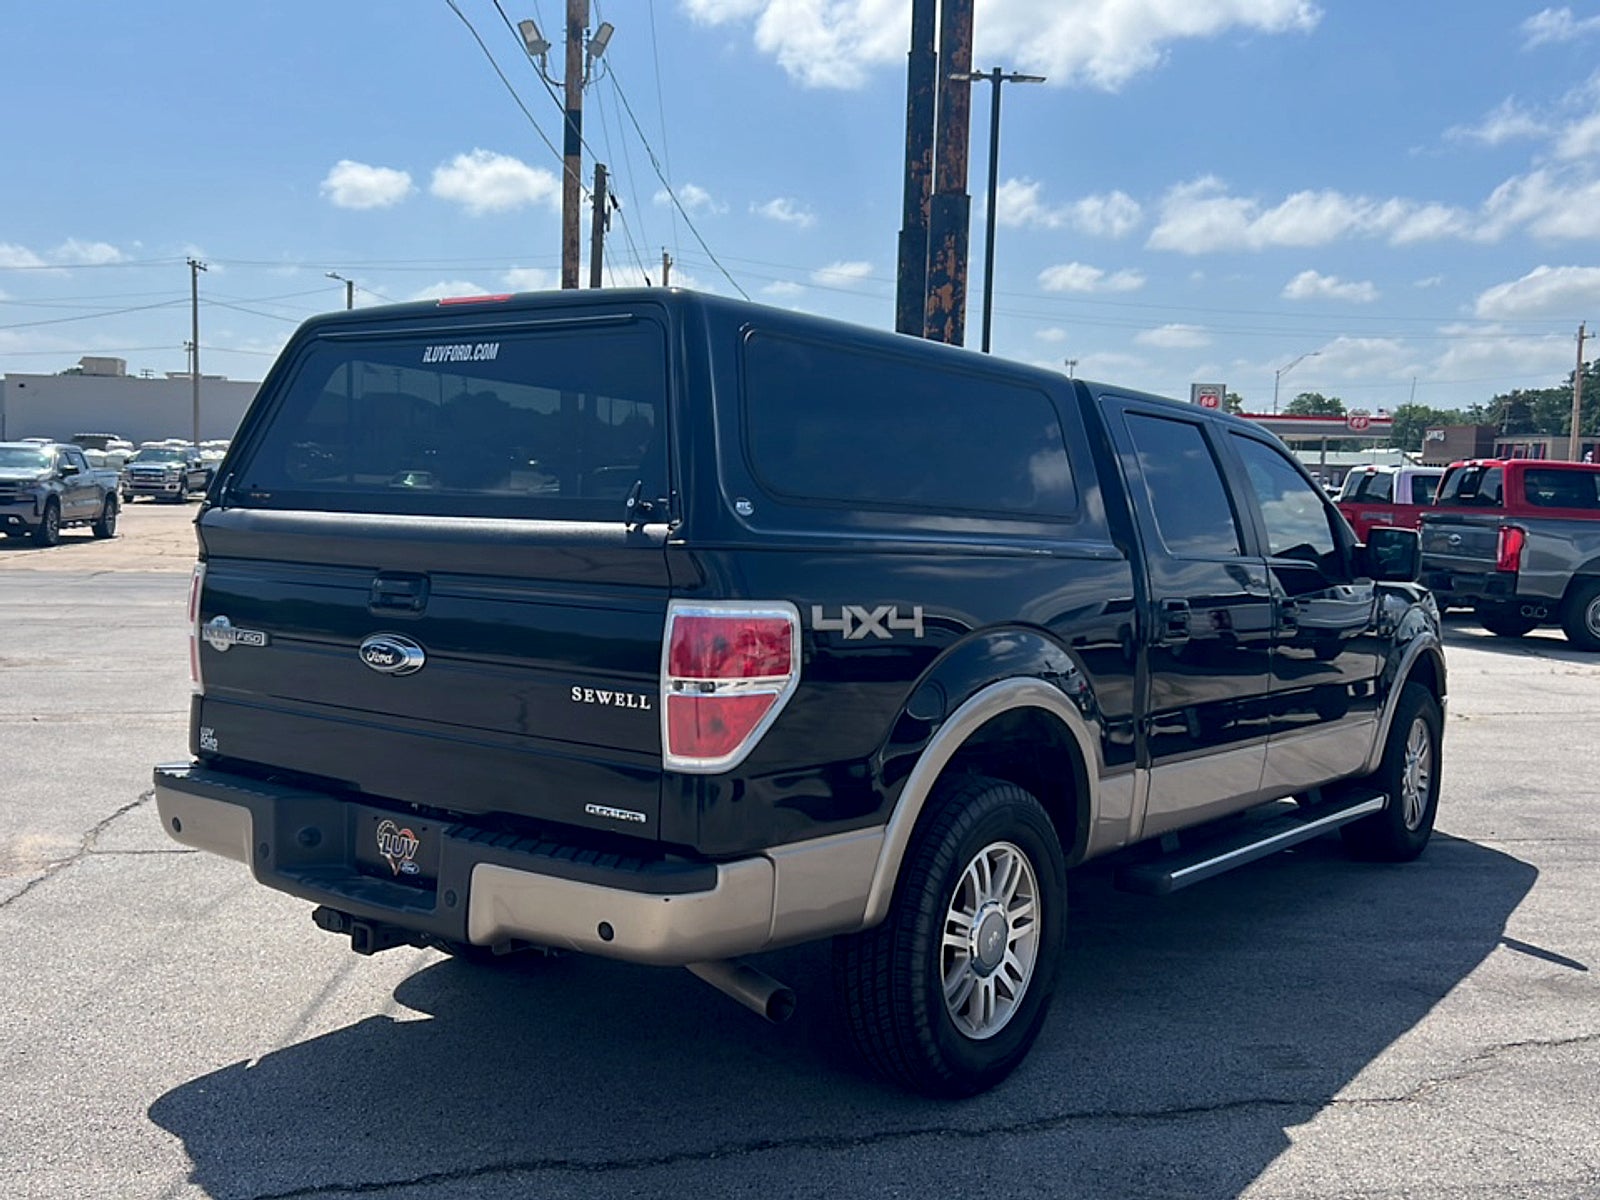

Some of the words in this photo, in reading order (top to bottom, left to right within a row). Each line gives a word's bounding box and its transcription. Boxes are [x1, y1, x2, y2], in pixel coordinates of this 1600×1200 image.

[1201, 396, 1216, 407] 66
[811, 604, 924, 640] 4X4
[366, 645, 394, 664] Ford
[571, 686, 652, 710] SEWELL
[380, 833, 420, 860] LUV
